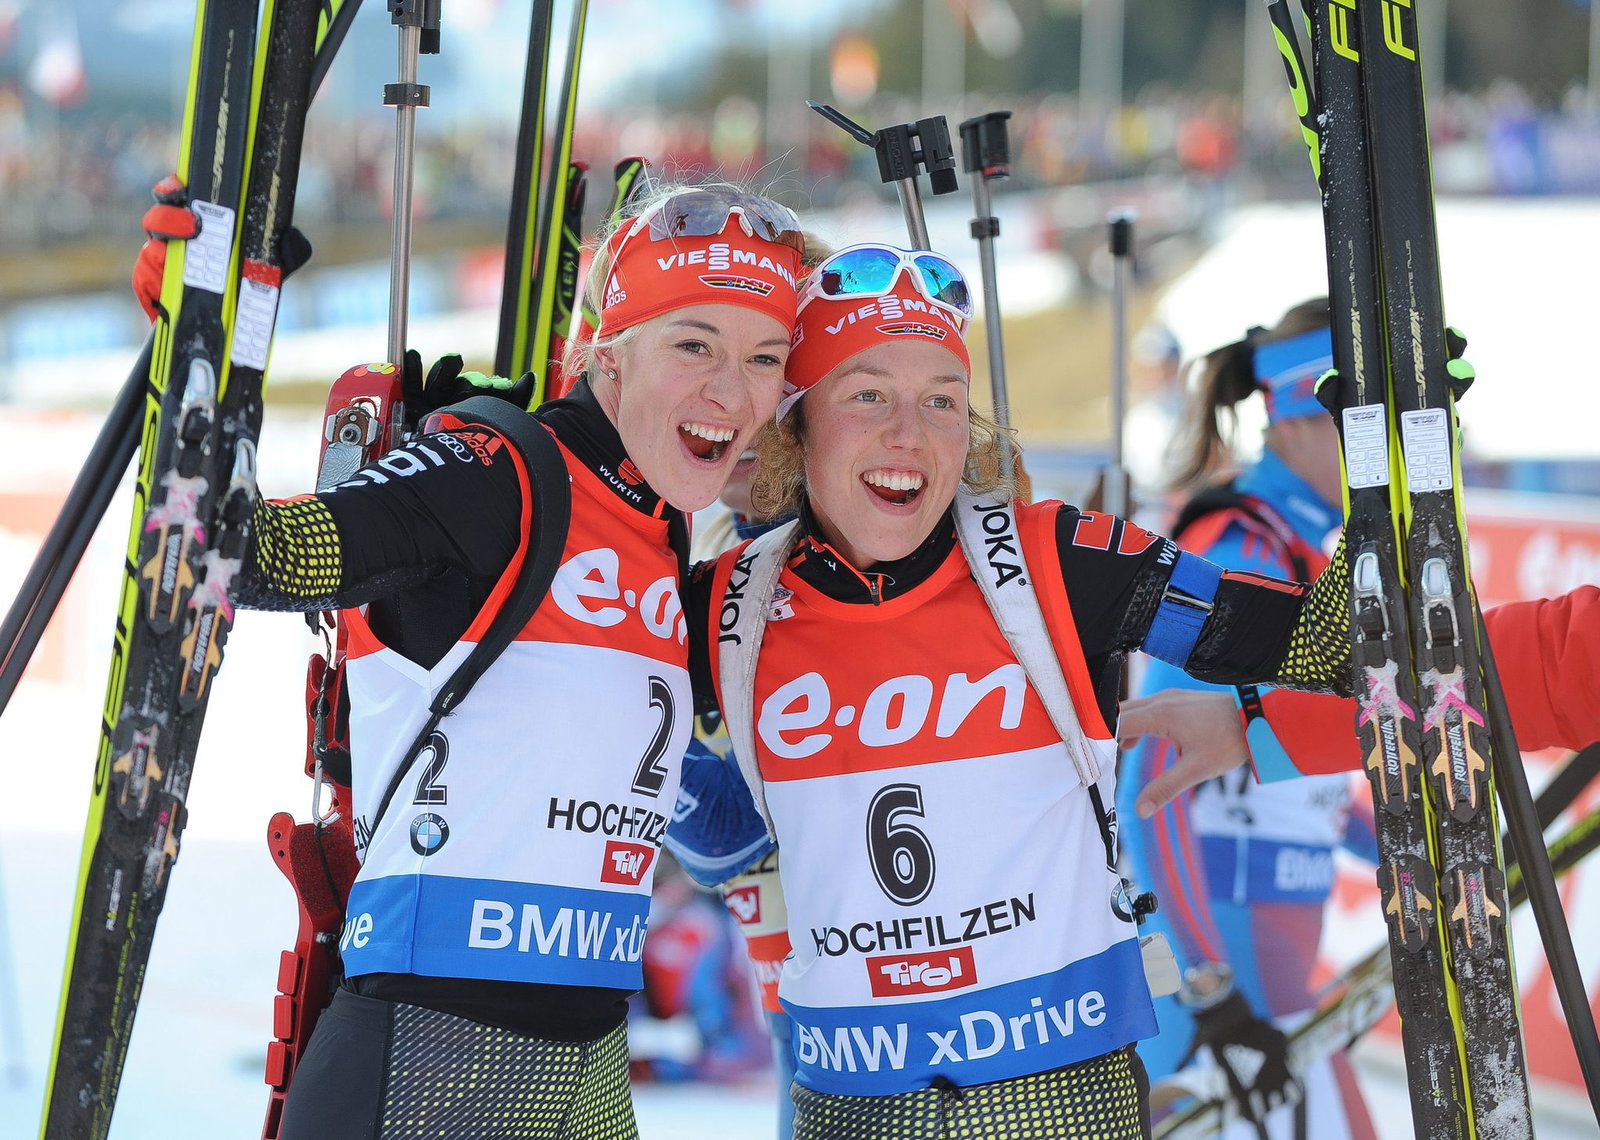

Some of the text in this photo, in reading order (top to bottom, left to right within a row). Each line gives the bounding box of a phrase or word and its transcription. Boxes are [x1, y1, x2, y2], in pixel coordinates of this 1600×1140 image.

[412, 729, 450, 806] 2
[631, 674, 677, 799] 2
[865, 781, 938, 907] 6
[468, 898, 612, 961] BMW
[810, 892, 1038, 957] HOCHFILZEN
[879, 955, 964, 988] Tirol
[796, 989, 1108, 1074] BMW xDrive
